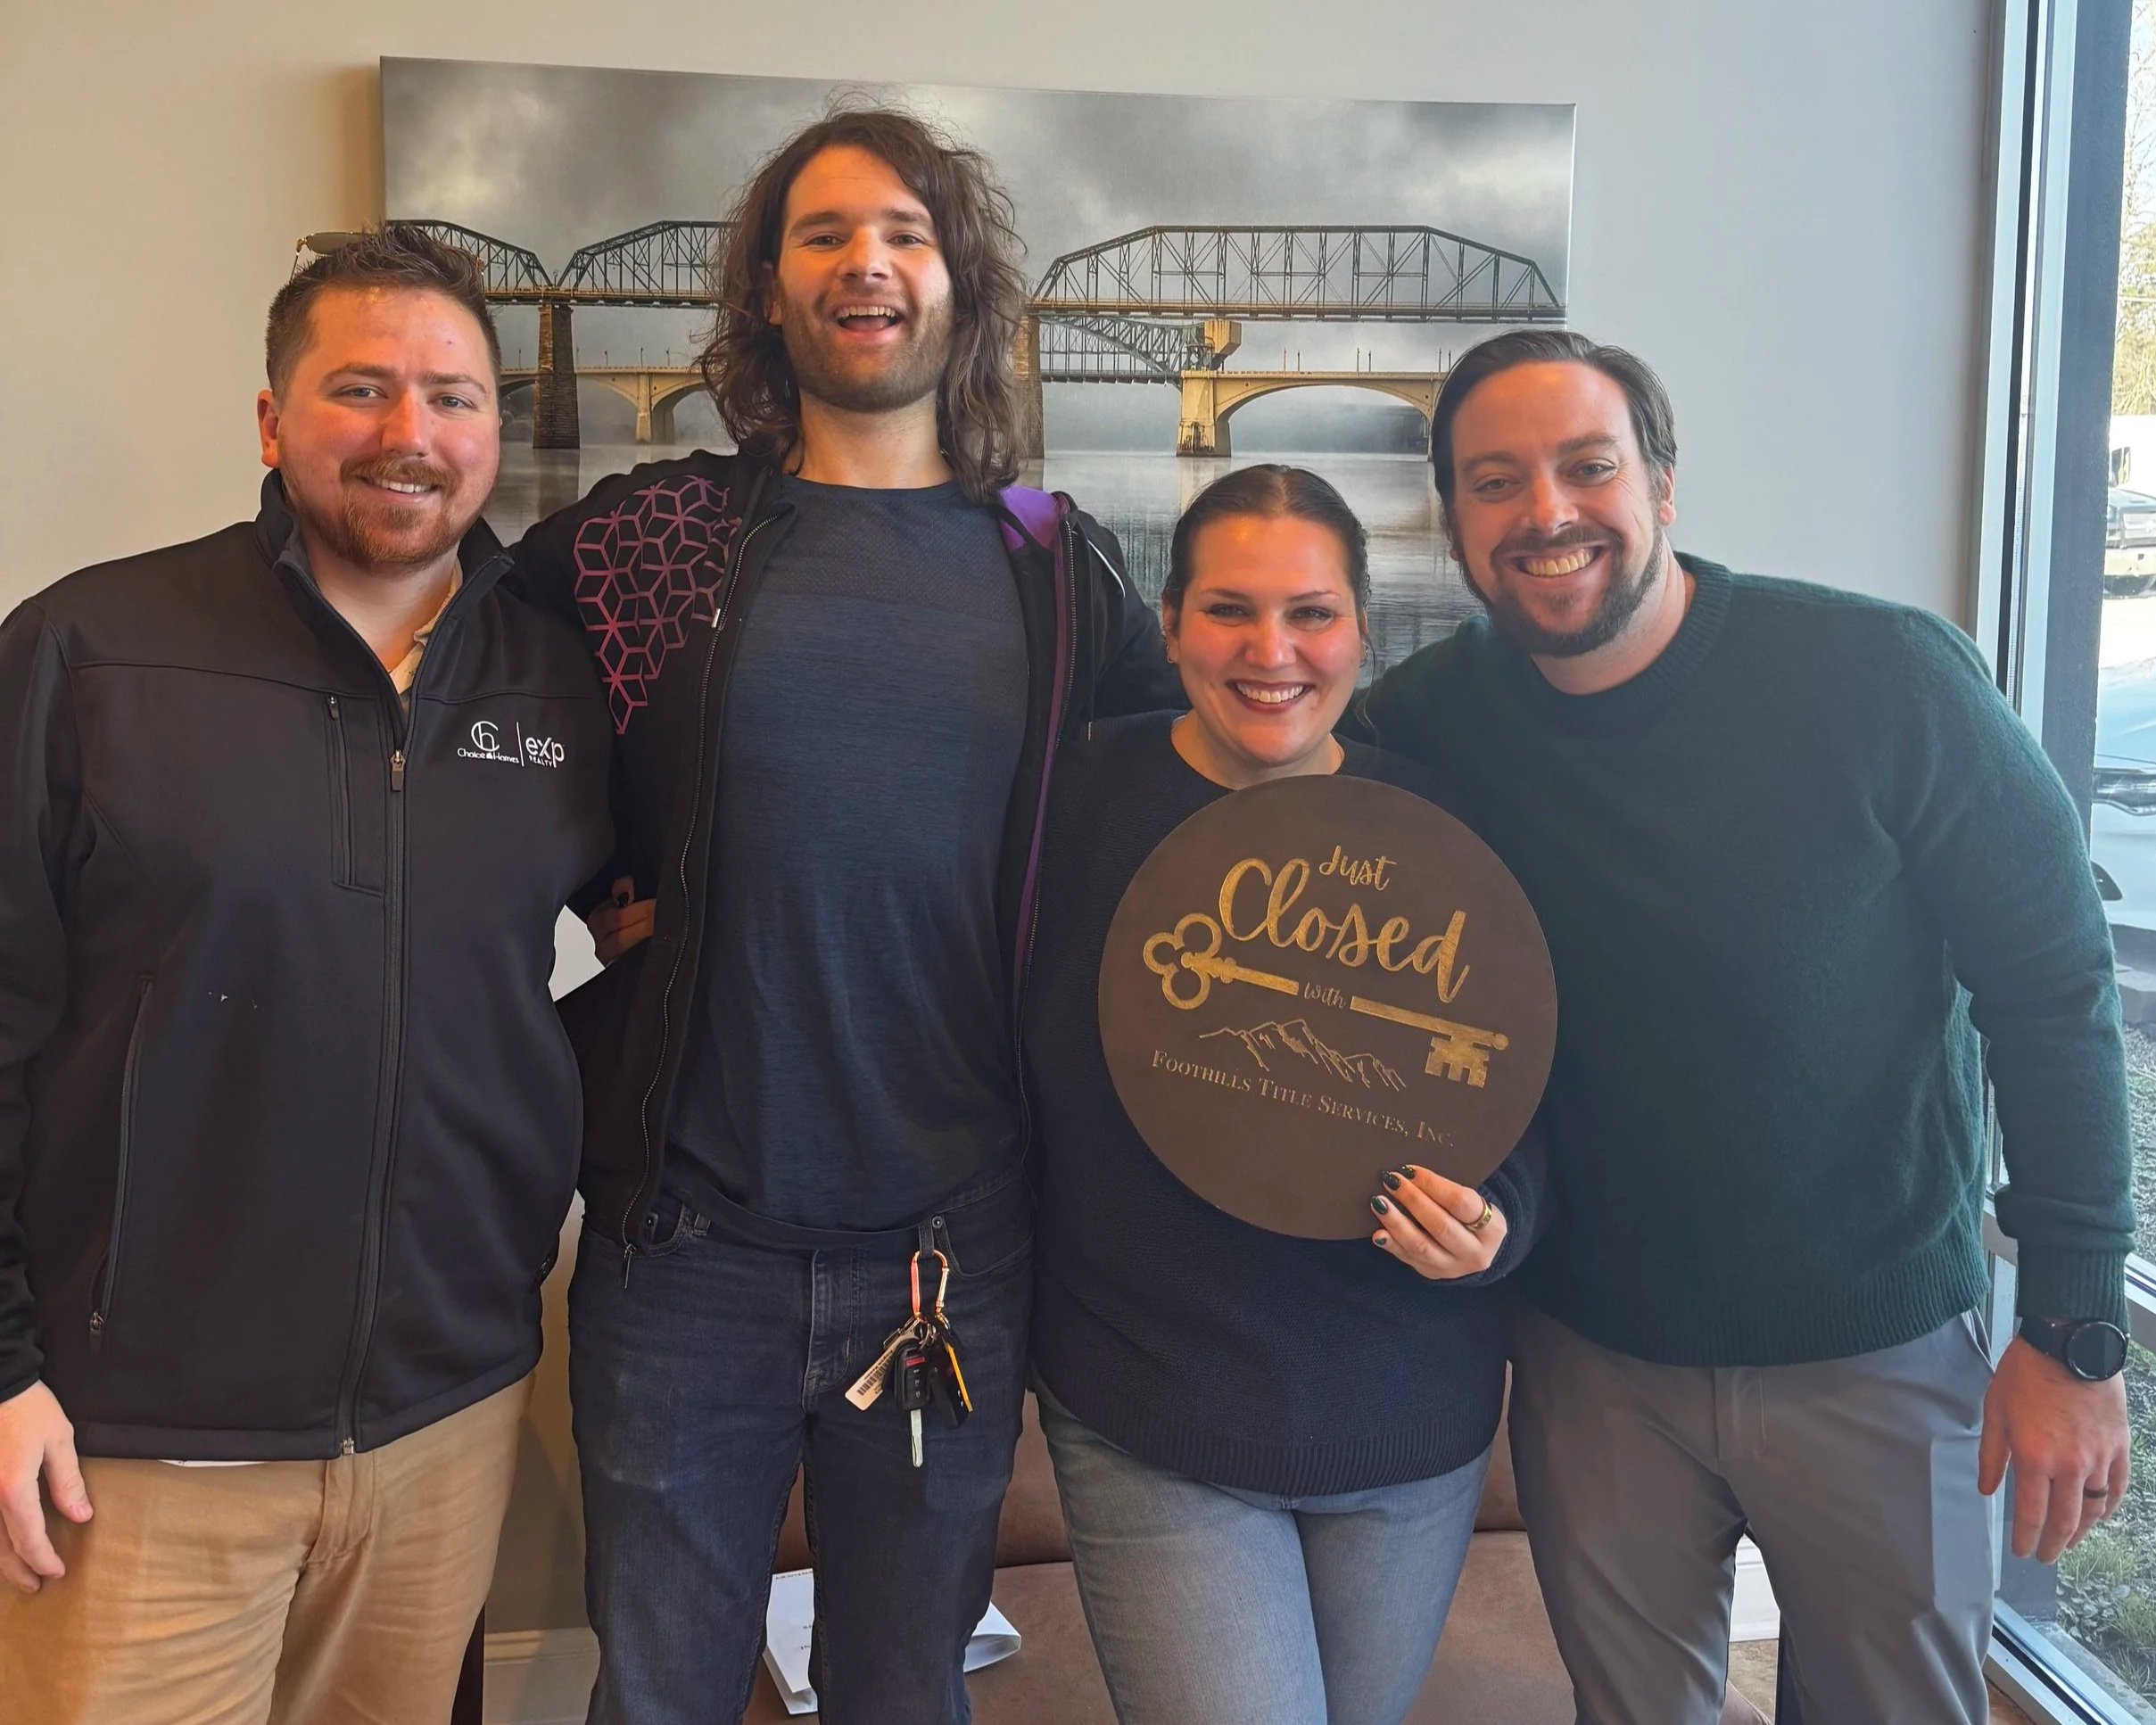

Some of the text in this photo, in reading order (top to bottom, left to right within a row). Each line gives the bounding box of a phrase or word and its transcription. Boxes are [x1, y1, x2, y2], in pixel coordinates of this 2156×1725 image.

[457, 747, 520, 763] Choice Homes
[1318, 845, 1397, 891] Just
[1218, 857, 1470, 1003] Closed
[1302, 981, 1347, 1010] with
[1259, 1077, 1313, 1108] TITLE
